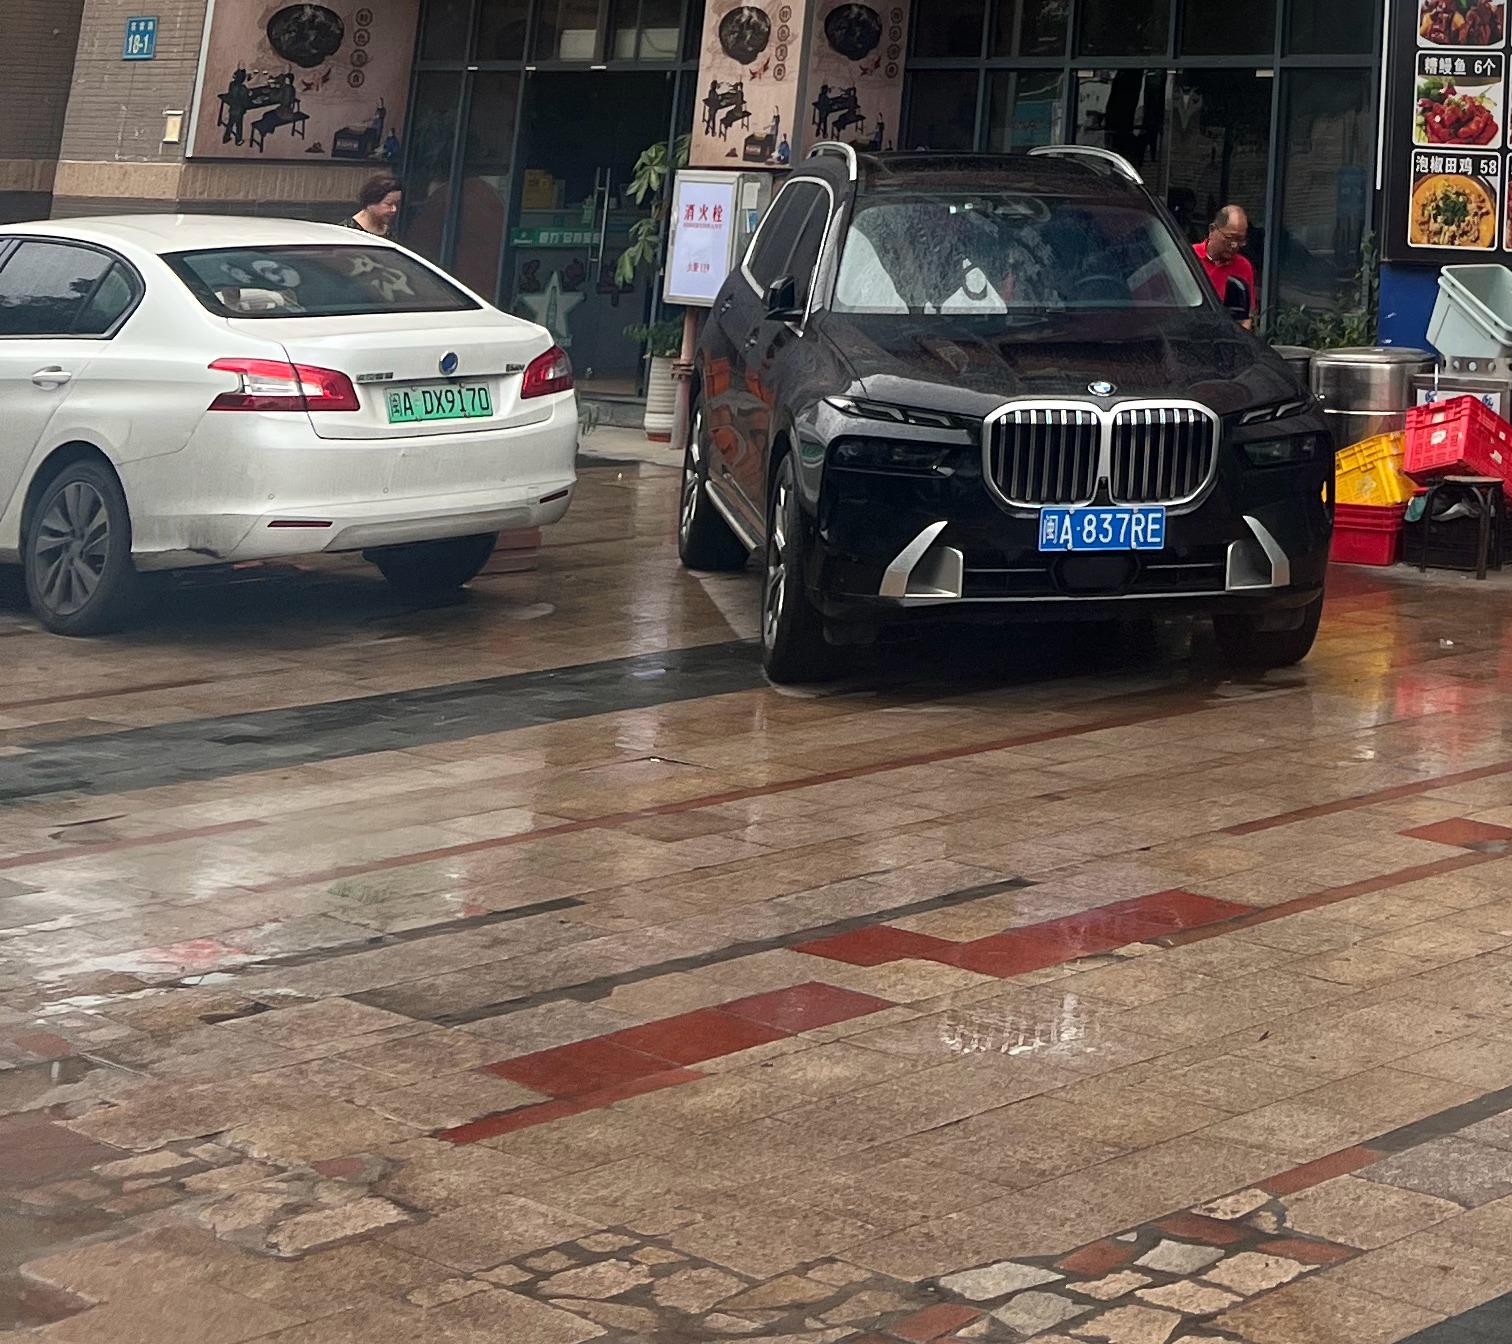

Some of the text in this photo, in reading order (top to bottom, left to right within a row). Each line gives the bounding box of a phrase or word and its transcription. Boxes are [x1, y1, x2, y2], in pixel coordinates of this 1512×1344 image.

[128, 34, 149, 53] 18-1
[1416, 155, 1497, 175] 泡椒田鸡 58
[684, 204, 723, 222] 消火栓
